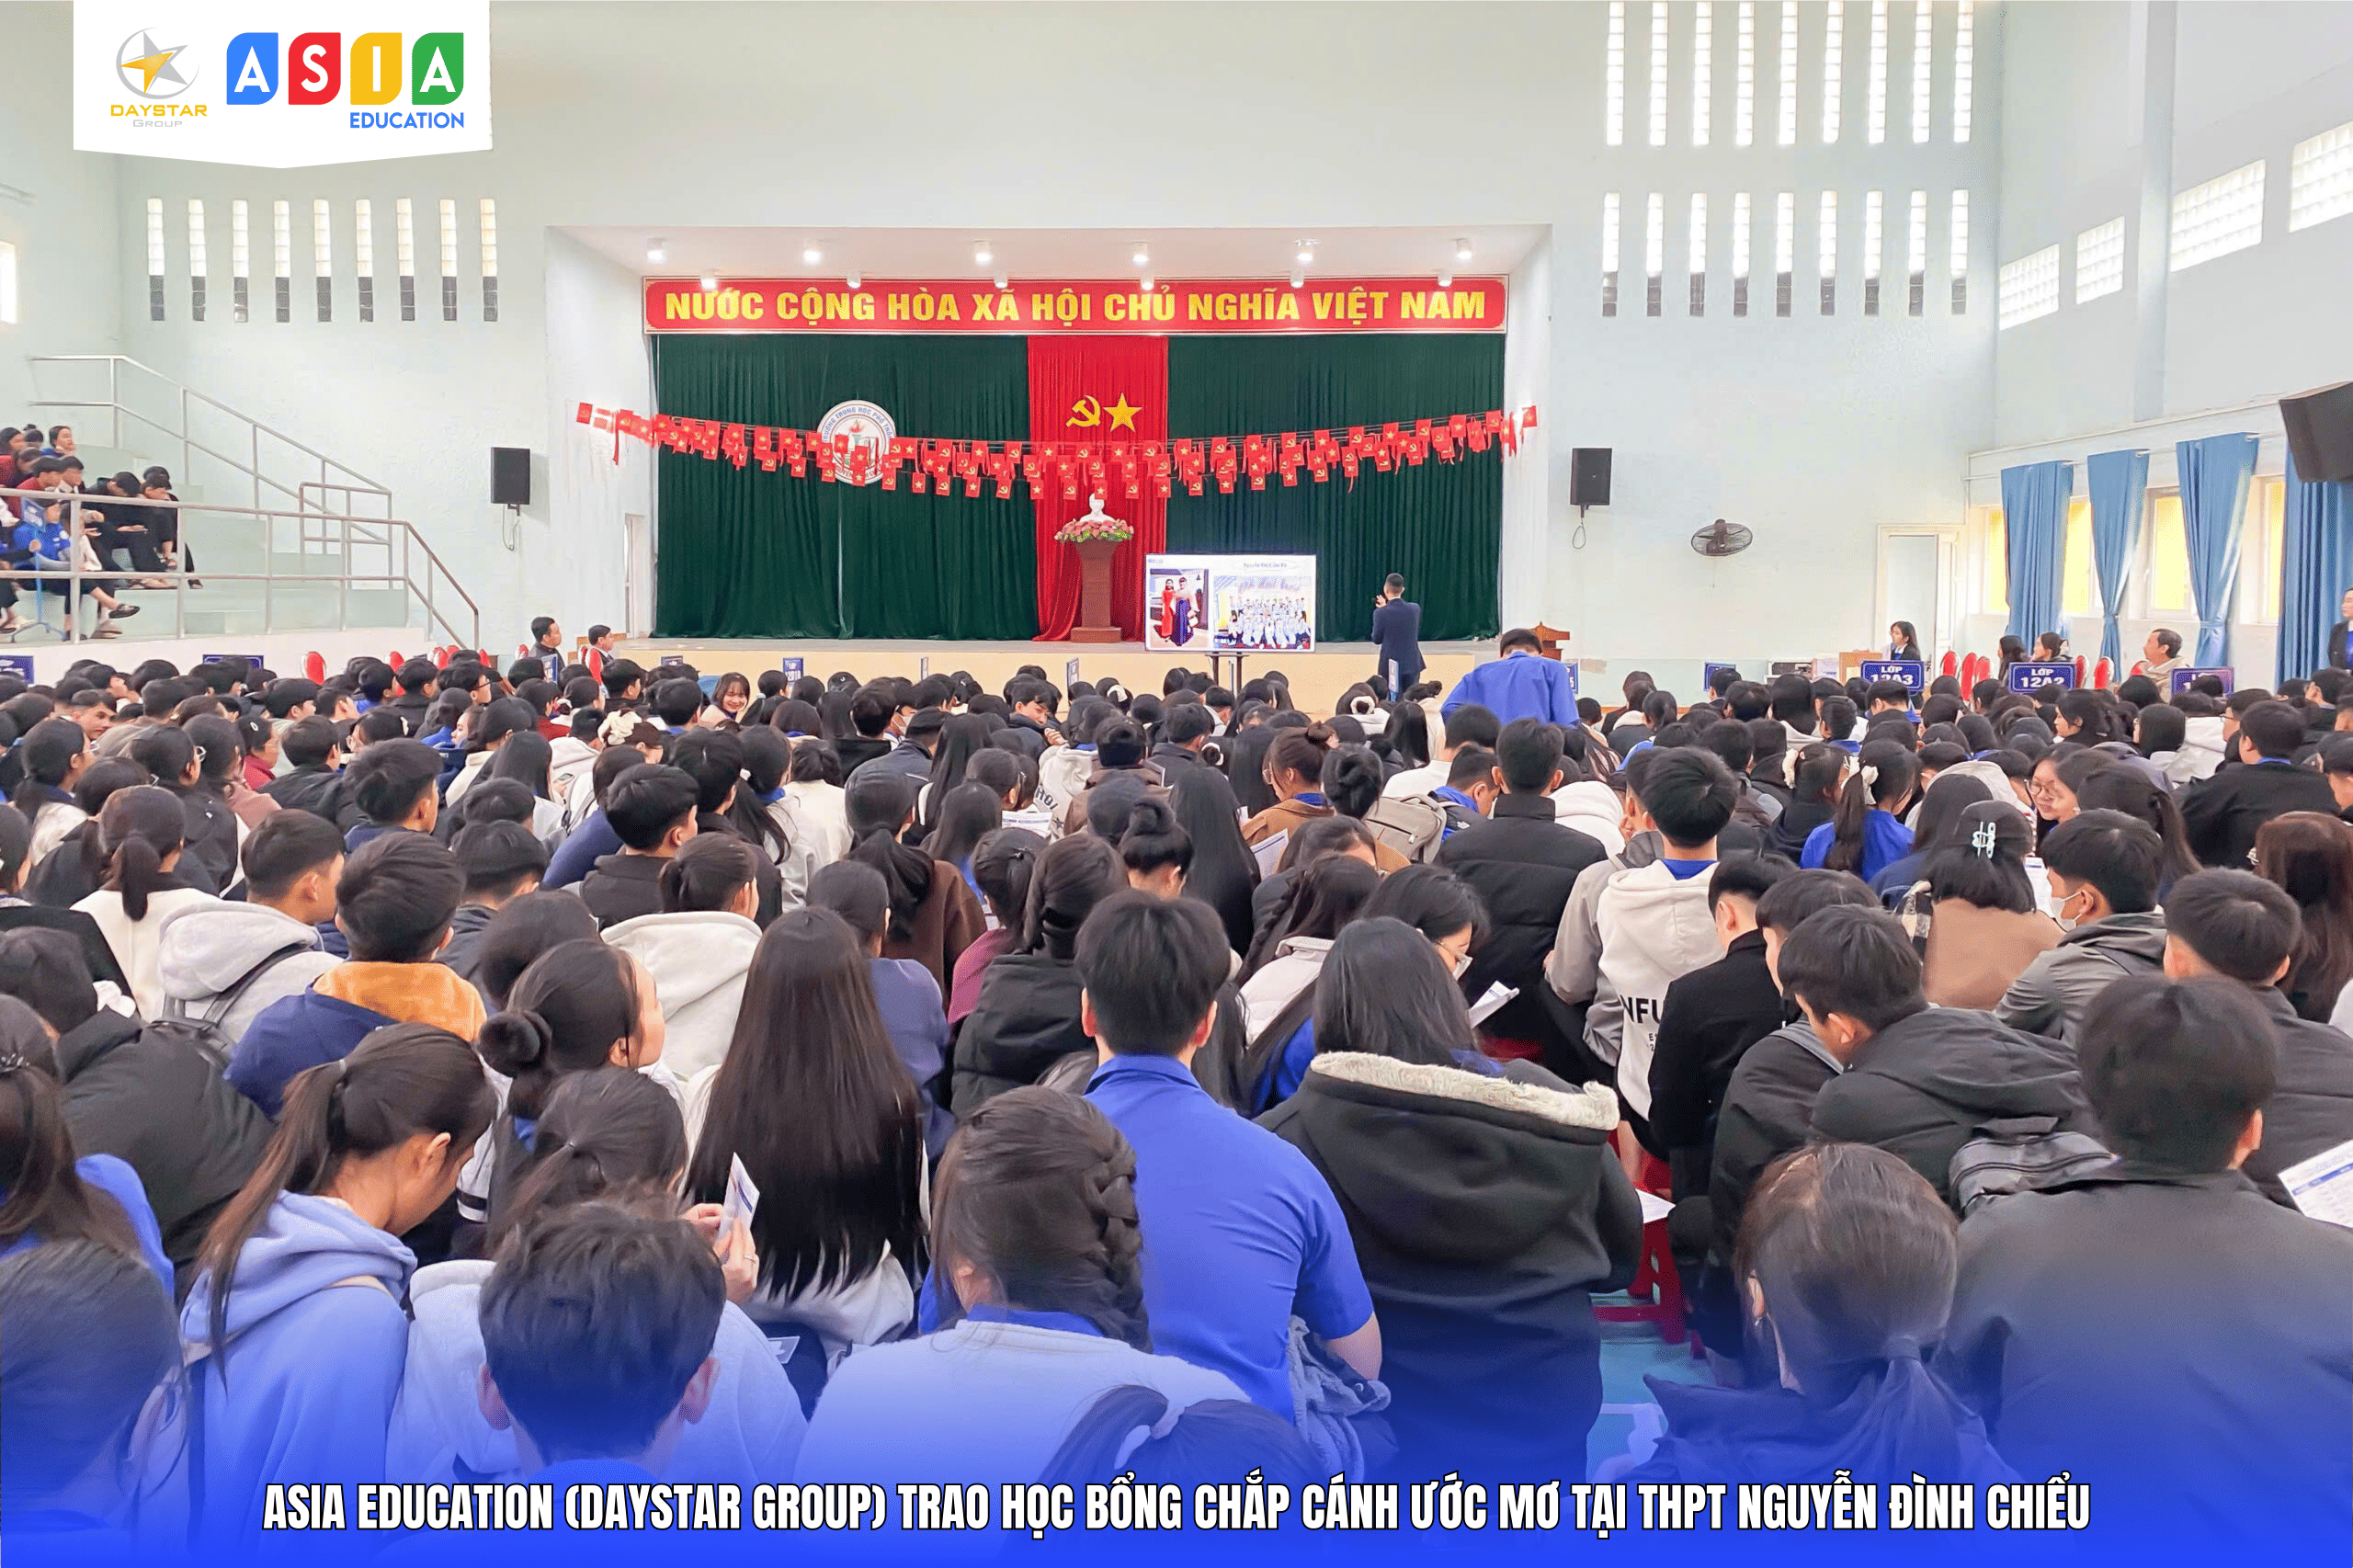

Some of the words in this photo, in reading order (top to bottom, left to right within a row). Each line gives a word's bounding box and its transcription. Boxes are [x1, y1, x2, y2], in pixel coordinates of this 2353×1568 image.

[665, 288, 765, 321] NƯỚC
[776, 287, 875, 325] CỘNG
[888, 287, 960, 321] HÒA
[972, 288, 1020, 322] XÃ
[1031, 288, 1091, 327] HỘI
[1103, 285, 1176, 321] CHỦ
[1188, 287, 1301, 321] NGHĨA
[1312, 286, 1389, 325] VIỆT
[1400, 291, 1486, 320] NAM
